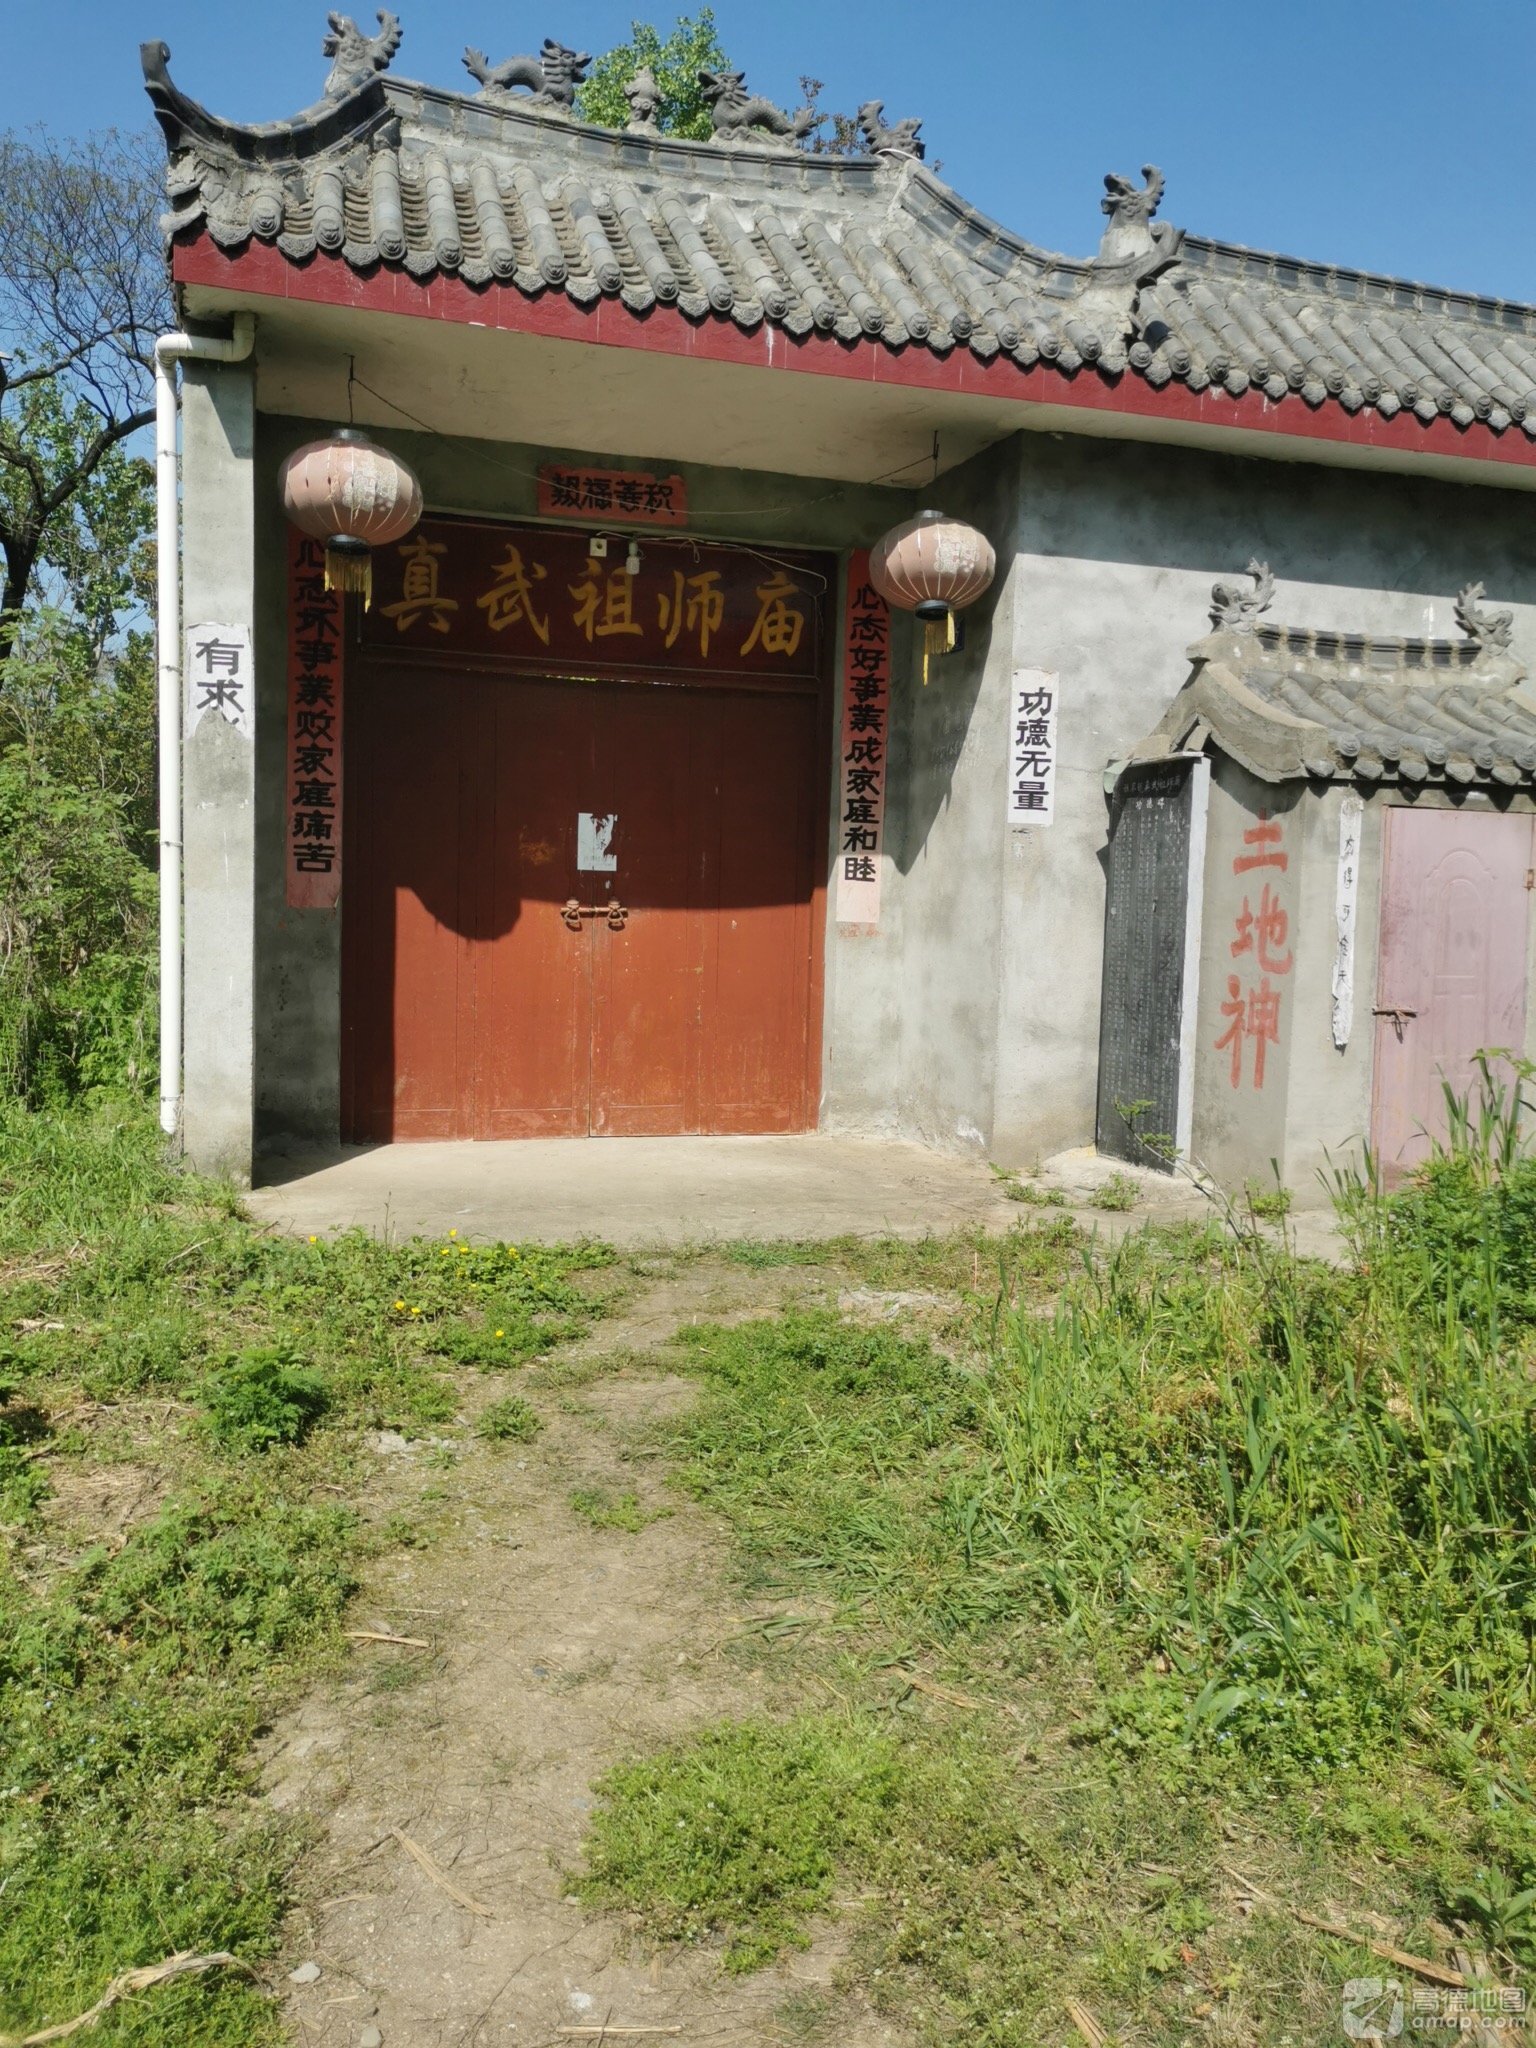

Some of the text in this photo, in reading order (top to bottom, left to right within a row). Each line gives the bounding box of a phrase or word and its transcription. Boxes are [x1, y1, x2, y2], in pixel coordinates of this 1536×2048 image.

[379, 535, 807, 658] 真武祖师庙
[195, 637, 245, 724] 有求
[1012, 687, 1053, 812] 功德无量
[1214, 807, 1294, 1090] 土地神
